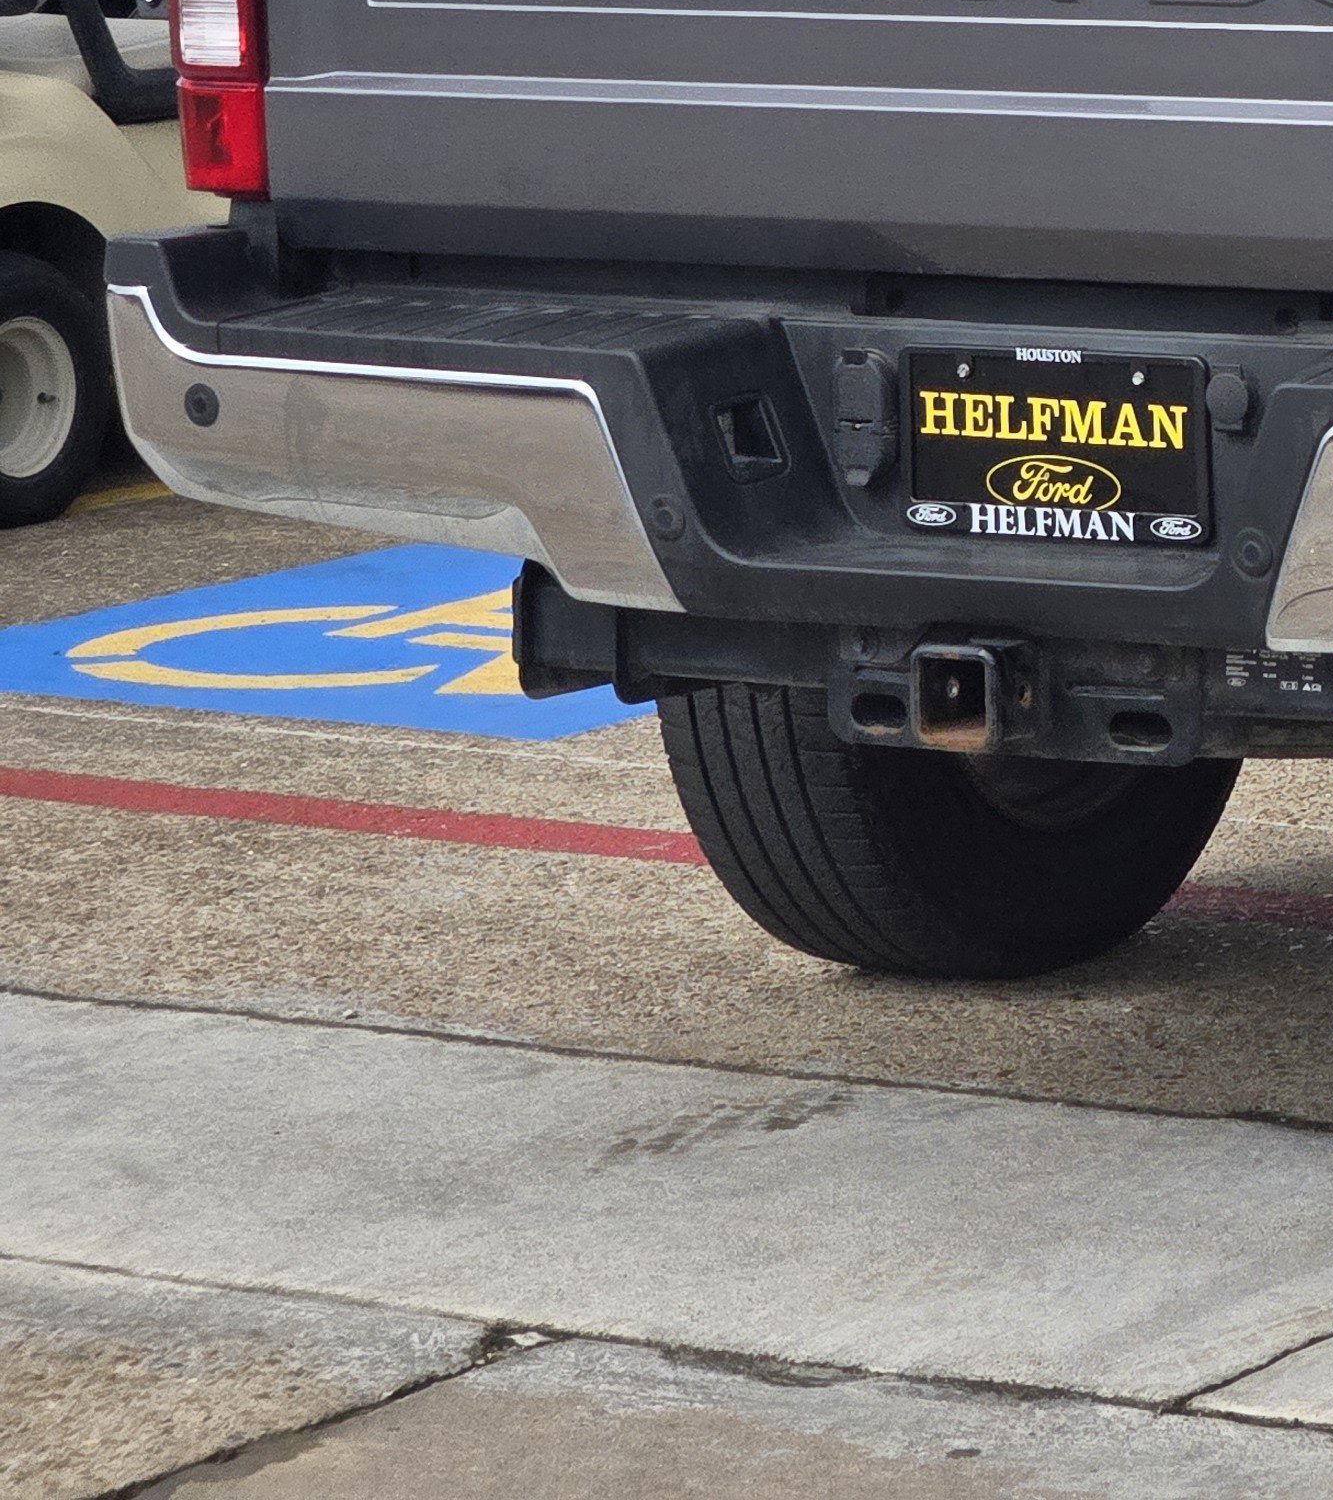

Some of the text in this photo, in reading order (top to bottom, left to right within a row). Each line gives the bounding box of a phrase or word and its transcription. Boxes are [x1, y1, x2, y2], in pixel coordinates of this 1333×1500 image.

[1015, 347, 1082, 365] HOUSTON
[919, 390, 1188, 450] HELFMAN
[1012, 461, 1094, 505] Ford
[914, 502, 1192, 542] Ford HELFMAN Ford
